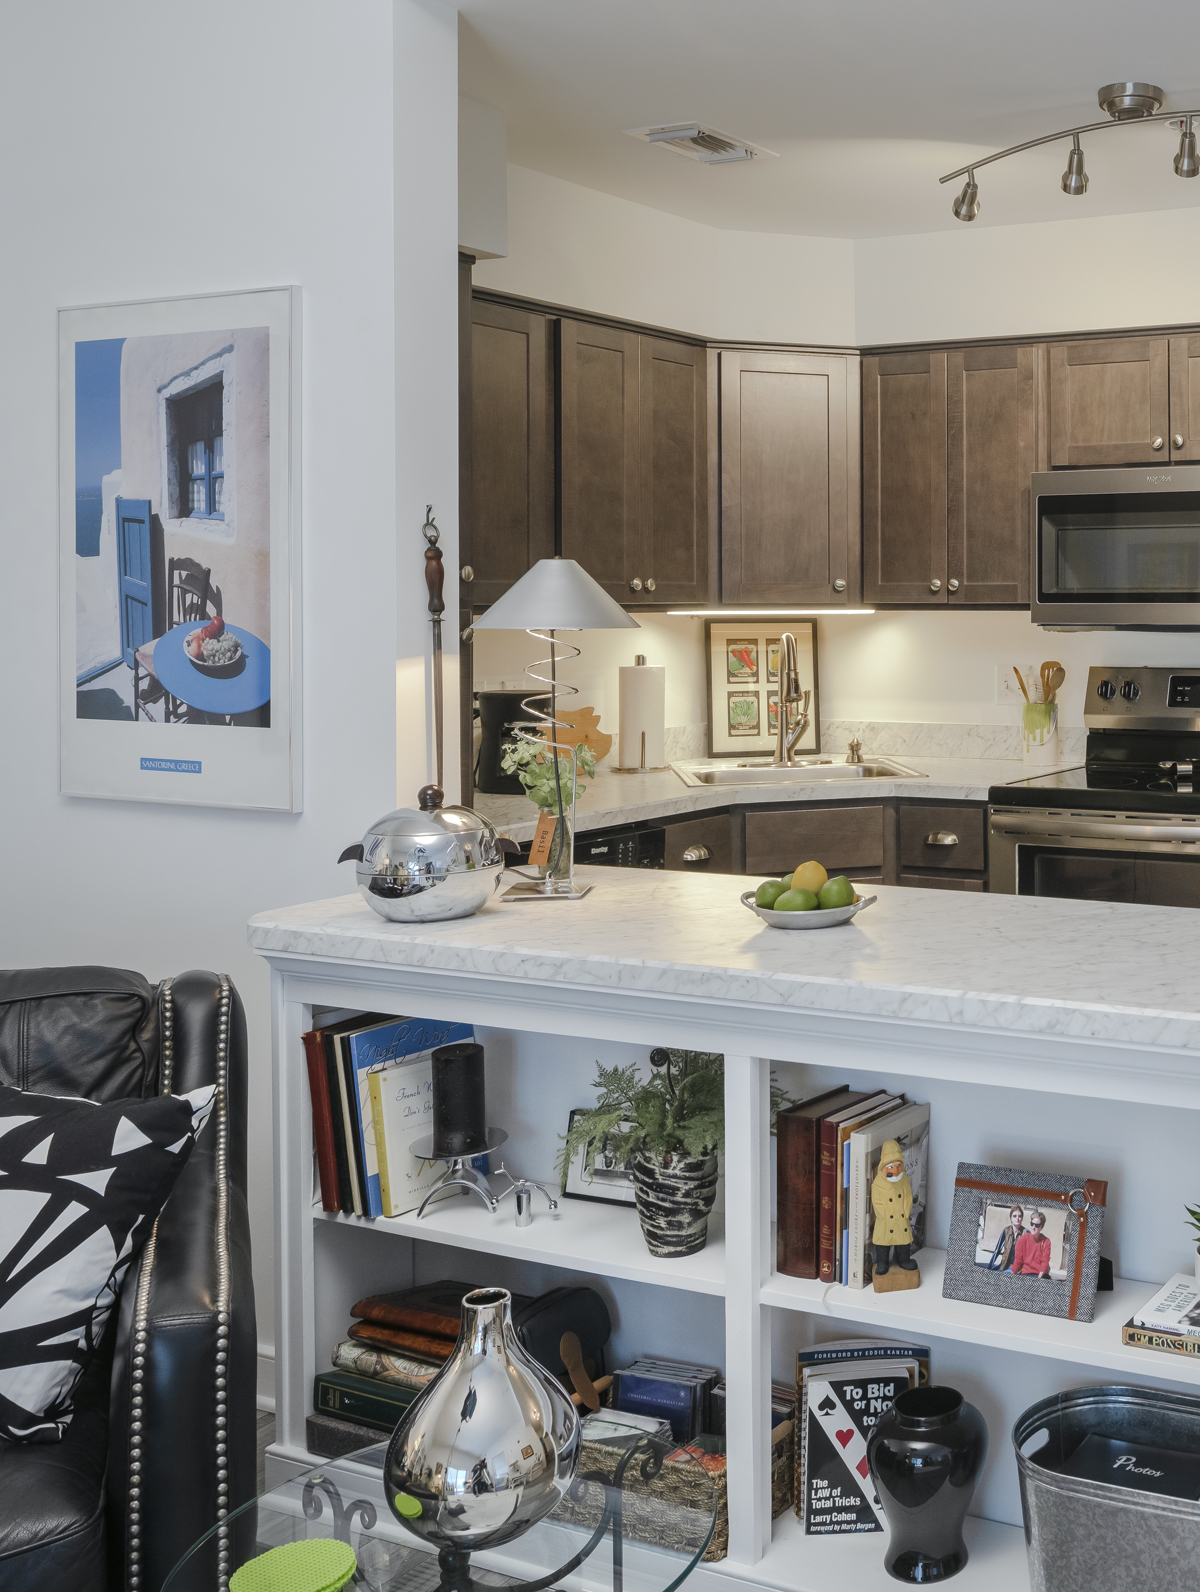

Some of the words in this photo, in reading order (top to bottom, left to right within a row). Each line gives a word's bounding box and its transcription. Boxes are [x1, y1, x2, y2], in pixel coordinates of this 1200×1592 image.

[177, 762, 200, 771] GREECE
[537, 830, 549, 854] Basil
[591, 846, 608, 855] Danby
[396, 1085, 421, 1102] French
[1153, 1302, 1173, 1314] MEG
[1163, 1290, 1184, 1304] GOES
[1175, 1283, 1190, 1291] TO
[1171, 1291, 1199, 1313] AMERICA
[843, 1385, 863, 1400] To
[867, 1382, 895, 1398] Bid
[853, 1400, 866, 1410] or
[869, 1398, 893, 1413] No
[863, 1415, 876, 1426] to
[1112, 1455, 1165, 1477] Photos
[811, 1479, 829, 1489] The
[811, 1488, 831, 1499] LAW
[831, 1486, 842, 1497] of
[811, 1497, 833, 1509] Total
[834, 1495, 861, 1507] Tricks
[810, 1514, 831, 1524] Larry
[831, 1511, 857, 1521] Cohen
[810, 1523, 834, 1532] foreword
[833, 1523, 841, 1531] by
[841, 1522, 857, 1531] Marty
[856, 1522, 876, 1531] Bergen
